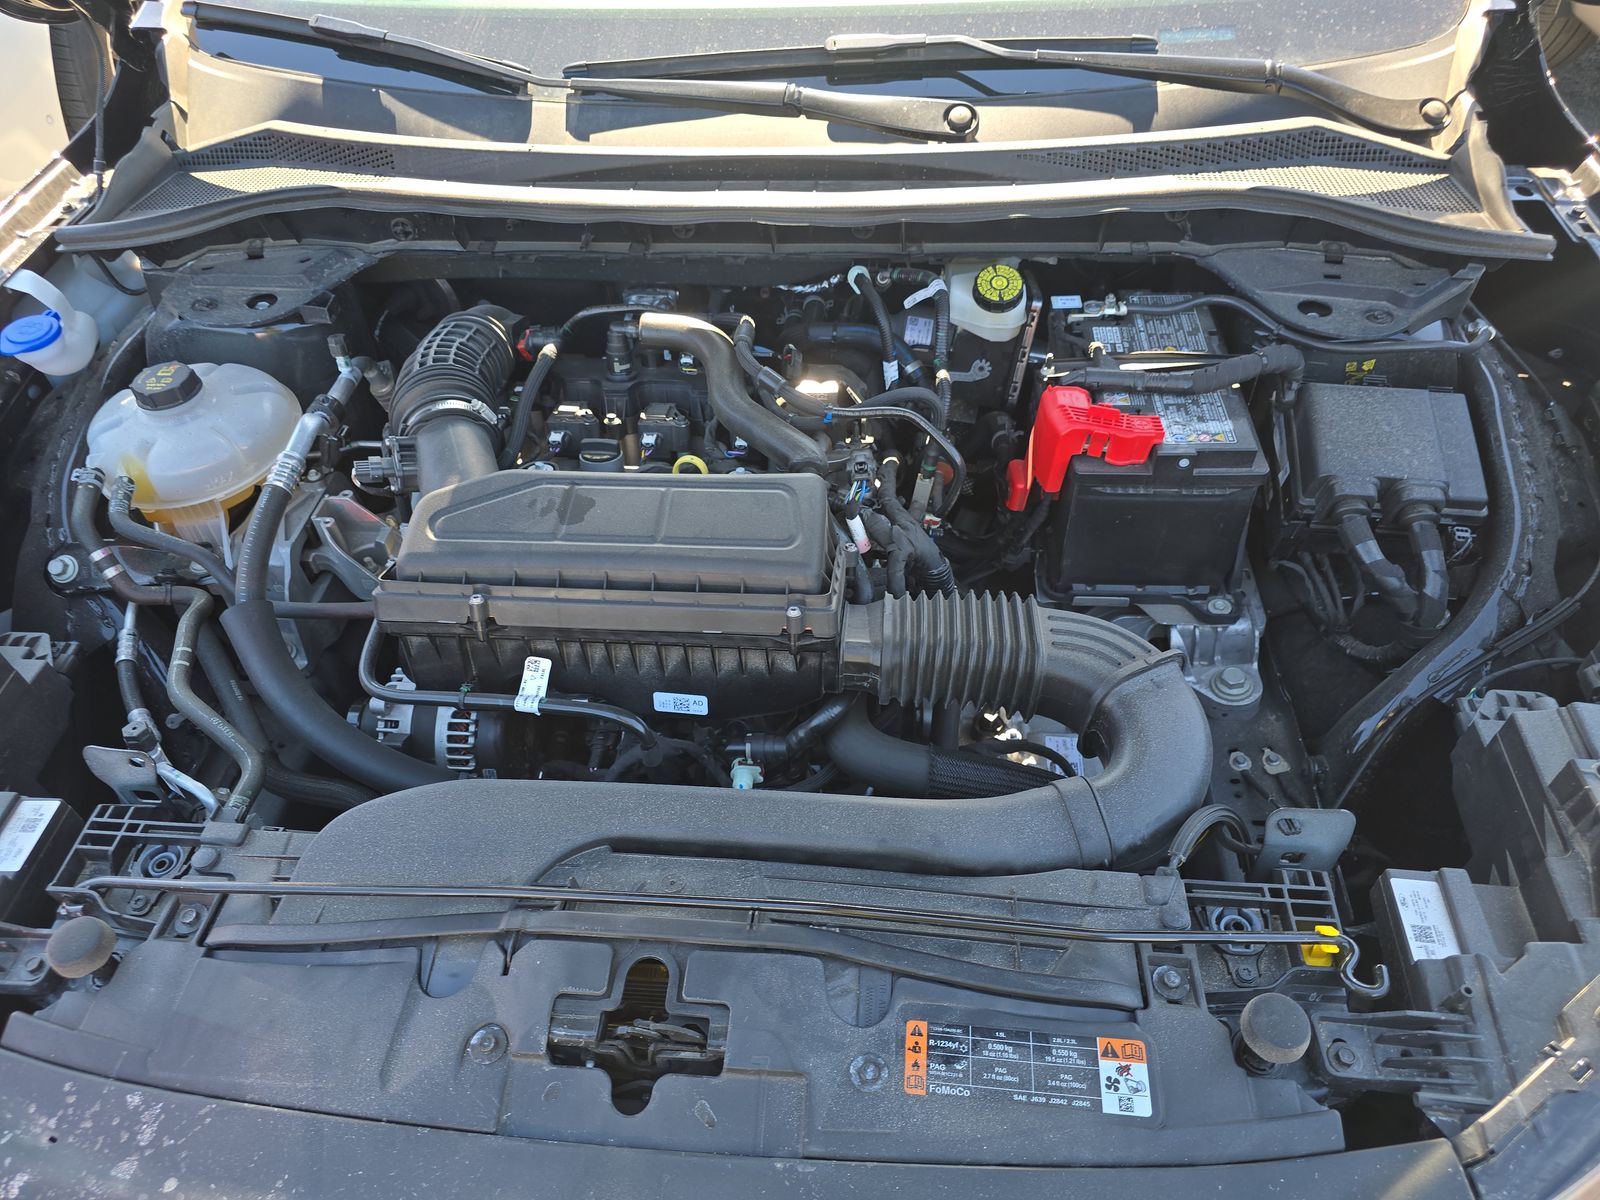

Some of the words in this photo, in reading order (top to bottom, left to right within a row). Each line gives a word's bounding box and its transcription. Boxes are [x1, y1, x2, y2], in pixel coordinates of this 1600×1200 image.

[929, 1040, 959, 1049] R-1234yf
[1069, 1050, 1078, 1058] kg
[929, 1085, 970, 1097] FoMoCo
